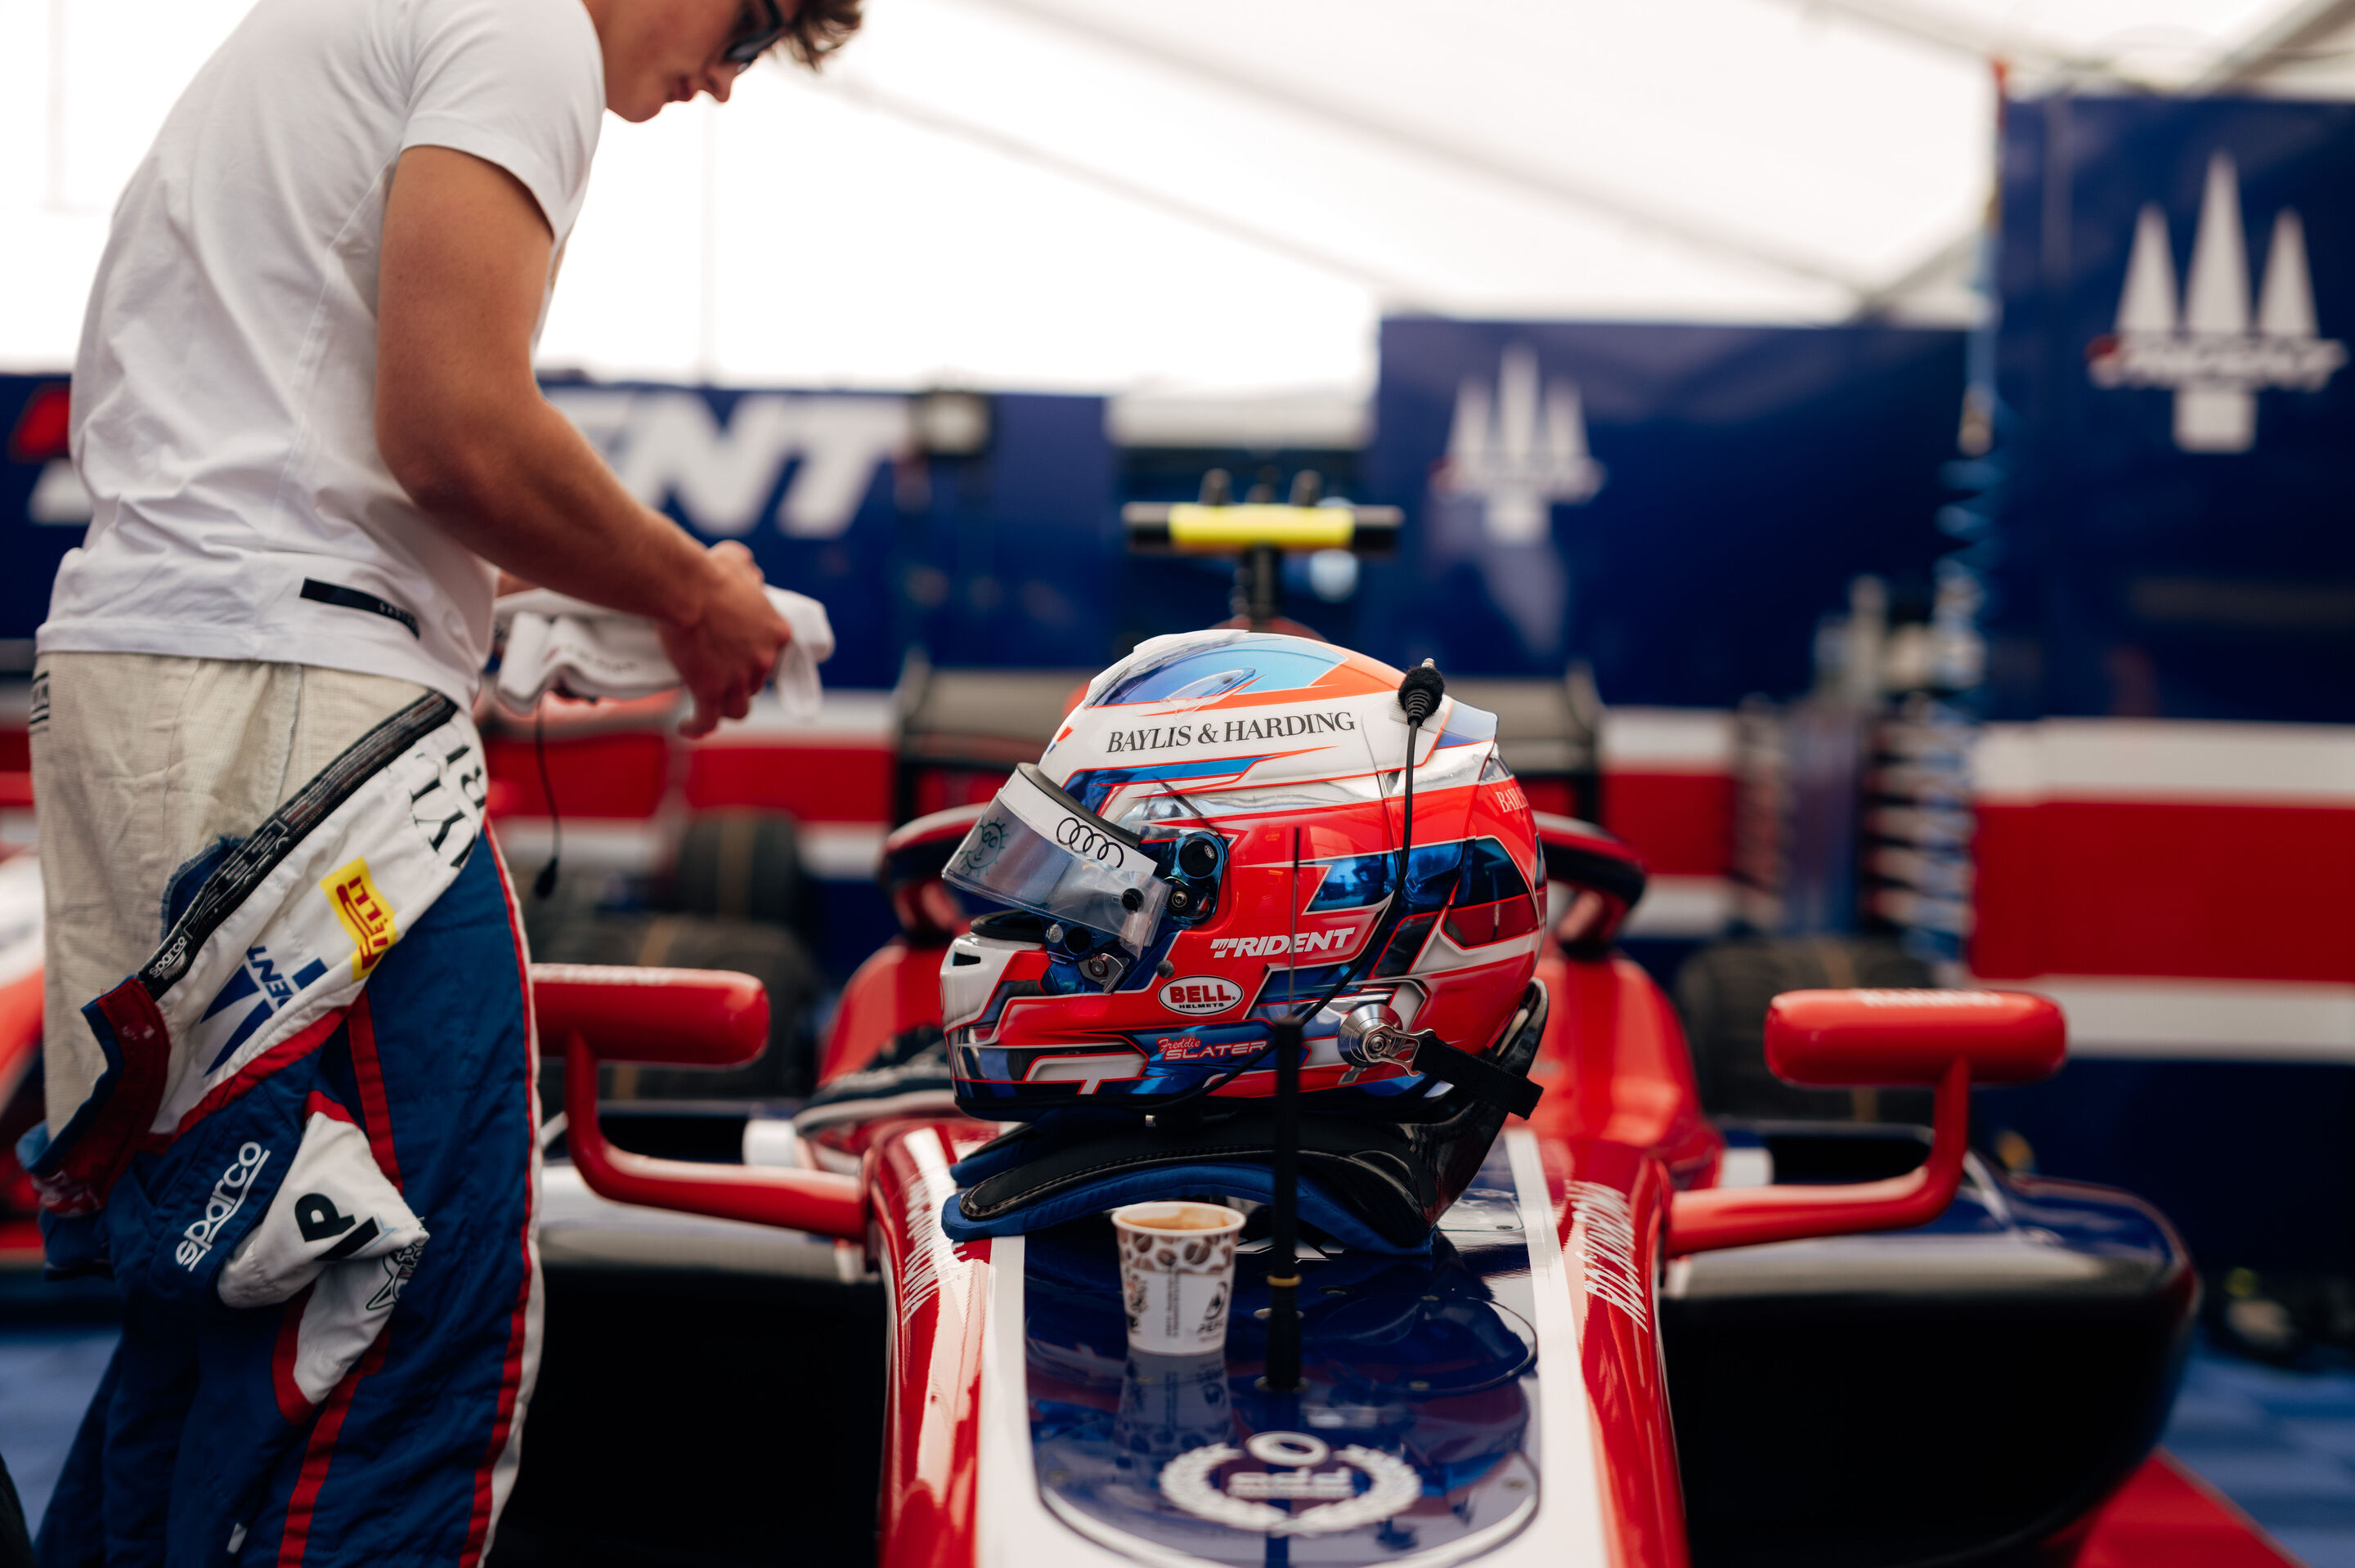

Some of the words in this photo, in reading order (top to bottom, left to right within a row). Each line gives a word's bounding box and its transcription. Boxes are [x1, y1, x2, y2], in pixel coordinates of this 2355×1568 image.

[1106, 725, 1192, 754] BAYLIS
[1197, 723, 1218, 744] &
[1222, 711, 1356, 742] HARDING
[149, 936, 188, 979] sparco
[1209, 926, 1356, 959] TRIDENT
[1169, 983, 1231, 1004] BELL
[1157, 1037, 1201, 1055] Freddie
[1164, 1040, 1268, 1061] SLATER
[175, 1141, 271, 1272] sparco
